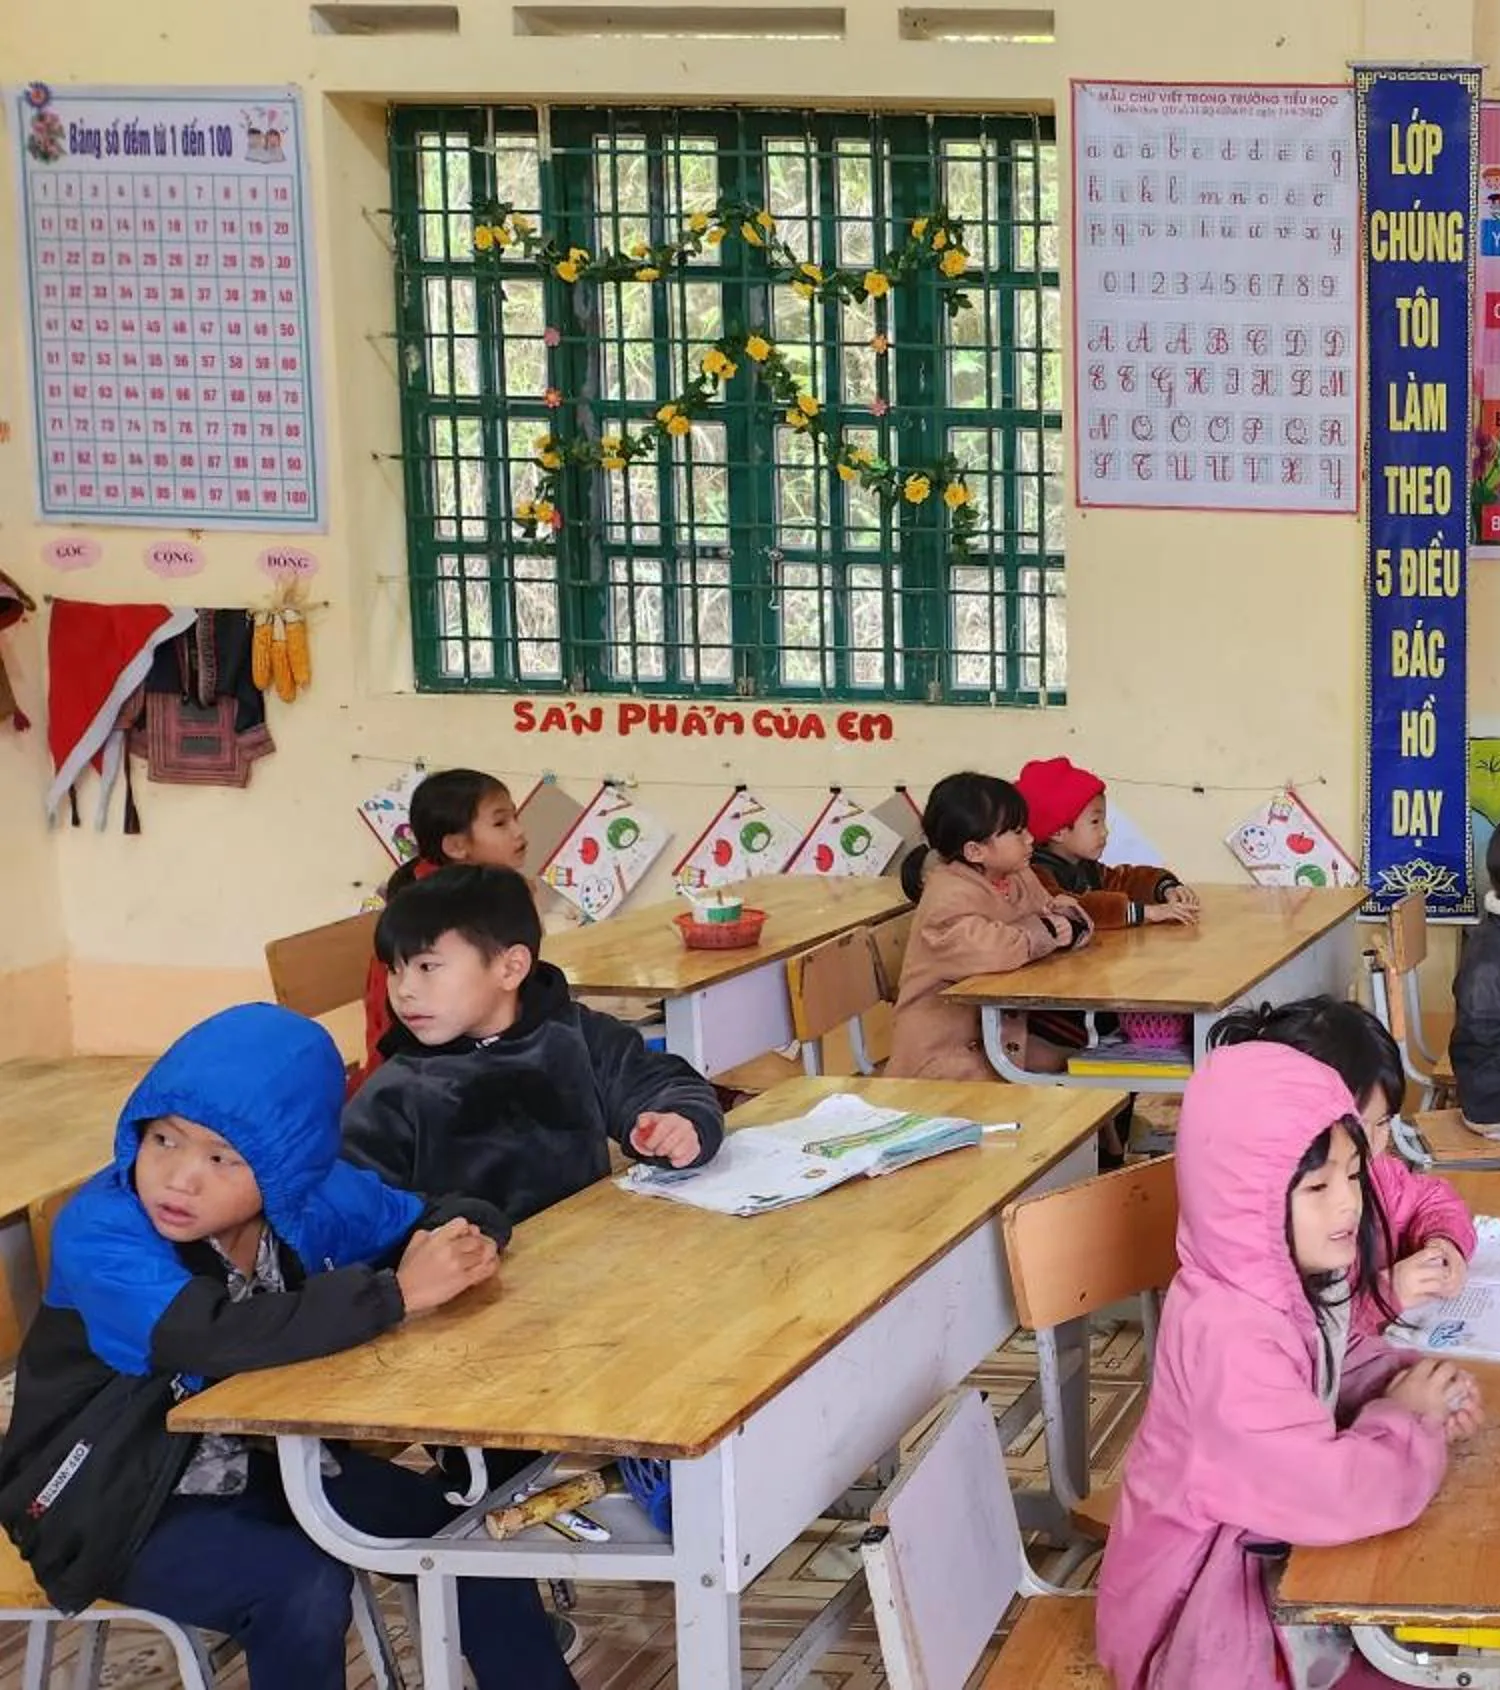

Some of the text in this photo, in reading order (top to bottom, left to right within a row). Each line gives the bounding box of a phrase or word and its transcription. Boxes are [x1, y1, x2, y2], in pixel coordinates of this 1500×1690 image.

[69, 117, 101, 159] Bảng
[105, 118, 120, 156] số
[124, 116, 150, 156] đếm
[170, 124, 177, 156] 1
[181, 117, 205, 156] đến
[209, 124, 233, 157] 100
[1391, 108, 1443, 175] LỚP
[1371, 199, 1464, 262] CHÚNG
[1104, 271, 1335, 298] 0 1 2 3 4 5 6 7 8 9
[1396, 286, 1439, 349] TÔI
[1388, 371, 1447, 433] LÀM
[1384, 465, 1452, 515] THEO
[1376, 531, 1461, 598] 5 ĐIỀU
[1391, 620, 1446, 680] BÁC
[513, 701, 894, 742] SẢN PHẨM CỦA EM
[1401, 694, 1438, 759] HỒ
[1392, 789, 1444, 847] DẠY
